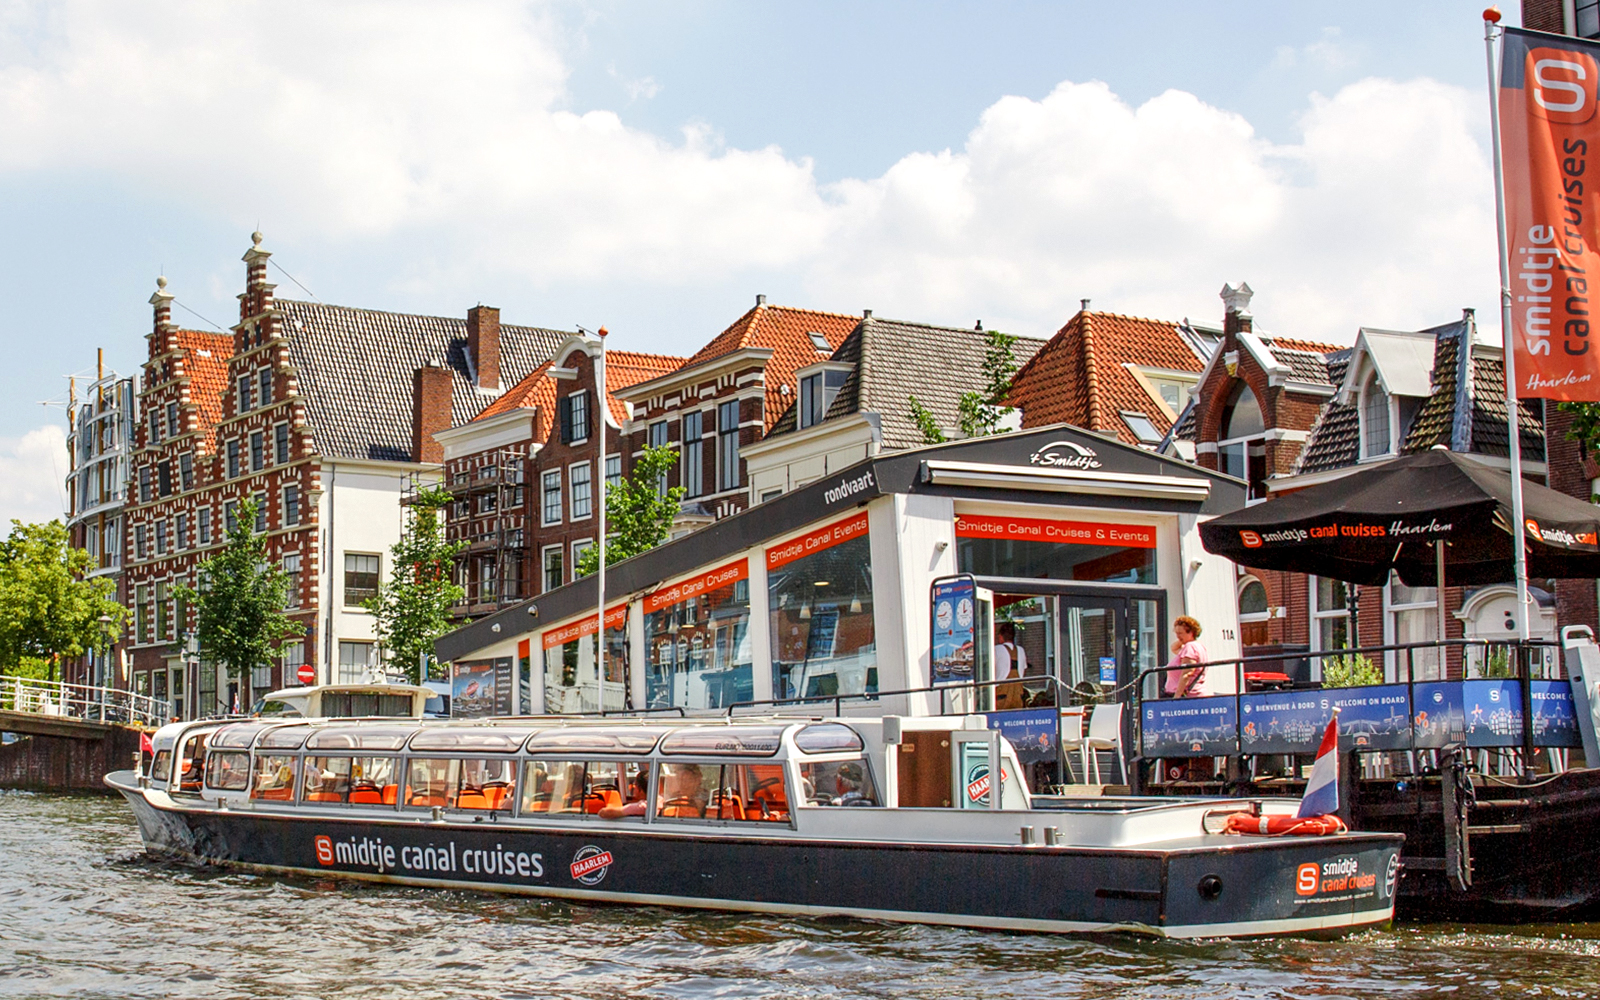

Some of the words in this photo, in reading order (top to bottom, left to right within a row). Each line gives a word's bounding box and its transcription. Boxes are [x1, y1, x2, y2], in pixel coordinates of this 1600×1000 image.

[1558, 138, 1588, 256] cruises
[1518, 224, 1562, 357] smidtje
[1559, 263, 1591, 356] canal
[1526, 369, 1592, 391] Haarlem
[1039, 452, 1103, 471] Smidtje
[823, 470, 875, 505] rondvaart
[957, 520, 1004, 535] Smidtje
[1007, 523, 1042, 536] Canal
[1045, 525, 1092, 539] Cruises
[1095, 528, 1106, 540] &
[1109, 529, 1150, 542] Events
[1262, 528, 1308, 543] smidtje
[1310, 523, 1338, 539] canal
[1340, 522, 1386, 537] cruises
[1389, 518, 1453, 537] Haarlem
[1540, 528, 1576, 546] smidtje
[769, 543, 803, 564] Smidtje
[805, 531, 831, 550] Canal
[833, 519, 868, 540] Events
[651, 586, 680, 607] Smidtje
[682, 579, 705, 596] Canal
[706, 567, 739, 587] Cruises
[557, 626, 580, 641] leukste
[1222, 629, 1235, 640] 11A
[1255, 703, 1290, 712] BIENVENUE
[1291, 701, 1297, 710] À
[1298, 702, 1316, 710] BORD
[1334, 698, 1366, 708] WELCOME
[1381, 696, 1406, 705] BOARD
[1531, 692, 1566, 701] WELCOME
[1003, 719, 1026, 728] WELCOME
[1035, 718, 1052, 726] BOARD
[1160, 708, 1199, 718] WILLKOMMEN
[1211, 707, 1228, 715] BORD
[402, 842, 456, 872] canal
[462, 845, 544, 878] cruises
[573, 854, 609, 875] HAARLEM
[1322, 857, 1359, 877] smidtje
[1321, 874, 1349, 893] canal
[1348, 871, 1377, 889] cruises
